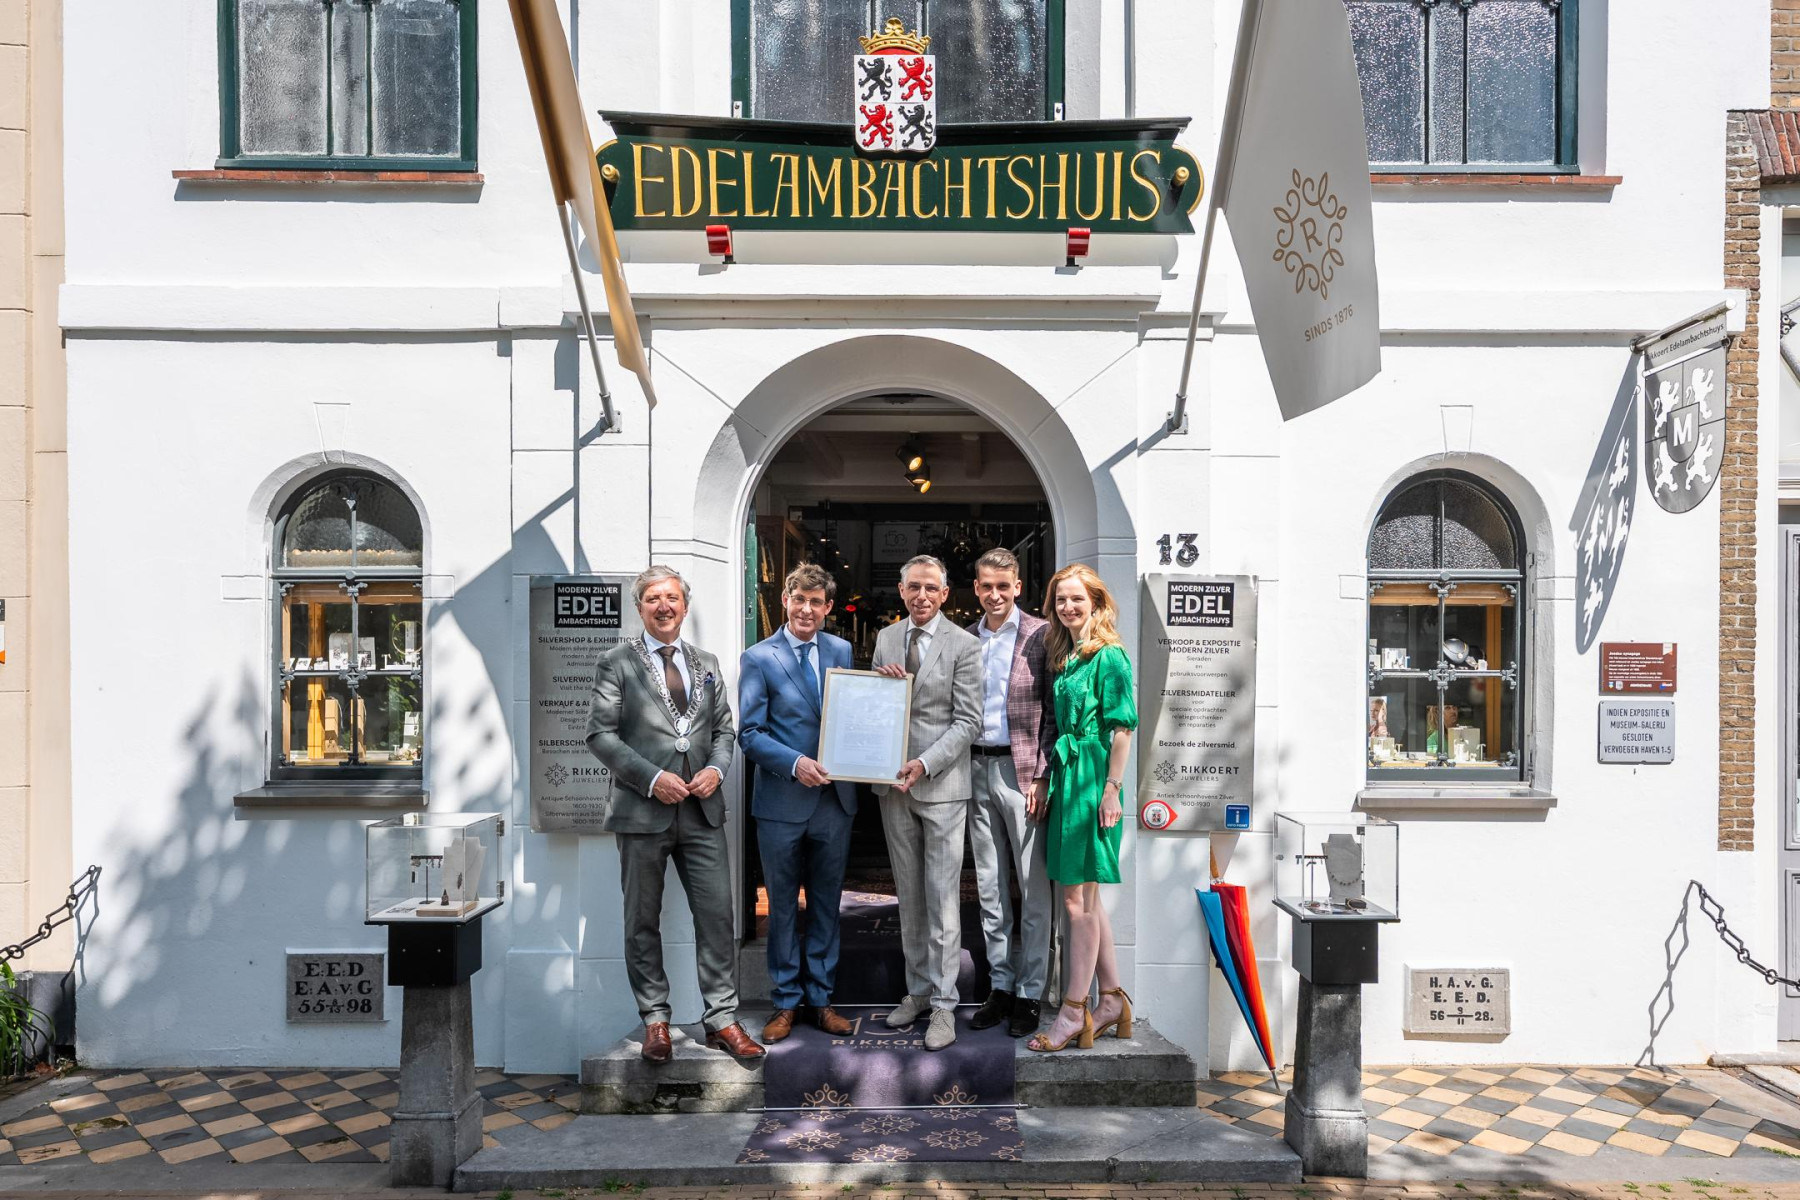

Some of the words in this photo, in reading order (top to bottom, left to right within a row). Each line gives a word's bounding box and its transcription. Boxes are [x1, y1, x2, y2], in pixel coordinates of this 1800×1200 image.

[631, 142, 1162, 222] EDELAMBACHTSHUIS
[1300, 217, 1323, 253] R
[1304, 317, 1333, 342] SINDS
[1334, 304, 1354, 326] 1876
[1670, 323, 1724, 352] Edelambachtshuys
[1673, 413, 1692, 447] M
[1156, 533, 1199, 568] 13
[557, 596, 618, 616] EDEL
[1170, 594, 1230, 614] EDEL
[1170, 616, 1230, 624] AMBACHTSHUYS
[1158, 638, 1194, 646] VERKOOP
[1202, 639, 1241, 647] EXPOSITIE
[1160, 690, 1236, 698] ZILVERSMIDATELIER
[1606, 708, 1628, 717] INDIEN
[1630, 709, 1660, 717] EXPOSITIE
[1662, 709, 1670, 717] EN
[1622, 733, 1653, 742] GESLOTEN
[1604, 746, 1640, 754] VERVOEGEN
[1640, 746, 1660, 754] HAVEN
[1662, 746, 1672, 754] 1-5
[572, 768, 608, 776] RIKKO
[1180, 765, 1240, 775] RIKKOERT
